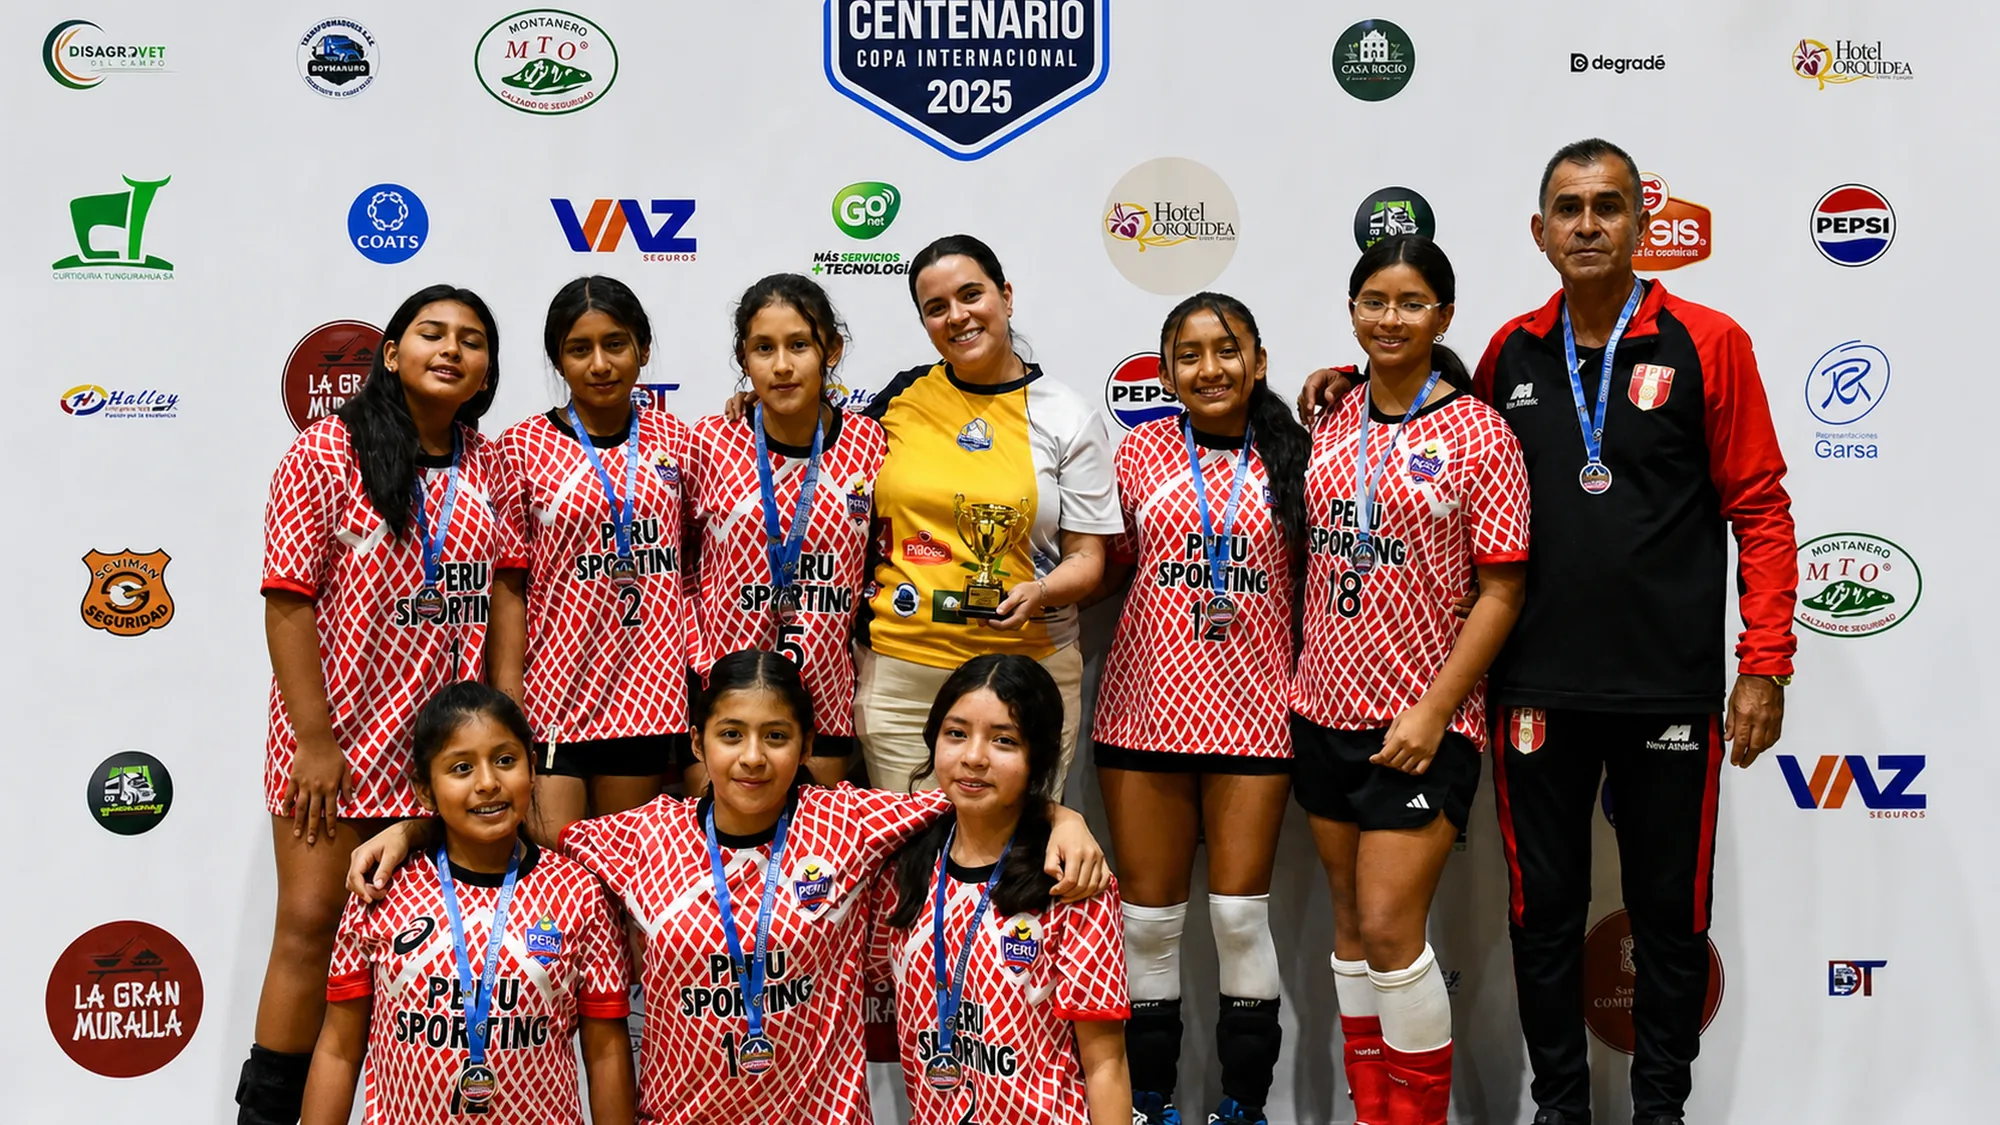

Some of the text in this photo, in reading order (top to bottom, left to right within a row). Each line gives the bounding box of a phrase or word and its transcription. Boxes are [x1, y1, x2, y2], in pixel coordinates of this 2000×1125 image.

[508, 17, 588, 37] MONTANERO
[848, 0, 1084, 39] CENTENARIO
[69, 45, 166, 58] DISAGROVET
[856, 49, 1078, 67] COPA INTERNACIONAL
[1836, 40, 1881, 60] Hotel
[1341, 64, 1407, 74] CASA ROCIO
[1592, 54, 1666, 74] degradé
[1833, 61, 1913, 75] ORQUIDEA
[501, 90, 537, 109] CALZADO
[927, 79, 1012, 114] 2025
[1154, 202, 1205, 221] Hotel
[550, 198, 696, 252] VAZ
[867, 217, 884, 226] net
[1152, 222, 1235, 236] ORQUIDEA
[1816, 216, 1889, 234] PEPSI
[357, 235, 419, 249] COATS
[1641, 219, 1699, 246] SIS
[643, 254, 696, 262] SEGUROS
[813, 251, 900, 262] MÁS SERVICIOS
[812, 261, 910, 275] +TECNOLOGÍ
[308, 373, 371, 394] LA GR
[108, 390, 180, 411] Halley
[1112, 385, 1179, 403] PEPS
[1815, 431, 1878, 440] Representaciones
[1814, 440, 1878, 459] Garsa
[601, 519, 659, 549] PRU
[1311, 527, 1406, 565] SPORNG
[1811, 541, 1891, 559] MONTANERO
[576, 547, 679, 580] SPOTIN
[1326, 569, 1362, 618] 18
[85, 604, 168, 628] SEGURIDAD
[395, 595, 490, 627] SRTIN
[619, 586, 642, 627] 2
[1800, 612, 1837, 630] CALZADO
[775, 625, 805, 671] 5
[1646, 741, 1666, 750] New
[1775, 755, 1926, 809] VAZ
[1869, 810, 1926, 819] SEGUROS
[1005, 942, 1037, 958] PERU
[74, 980, 180, 1009] LA GRAN
[72, 1008, 182, 1041] MURALLA
[956, 1000, 984, 1035] ERU
